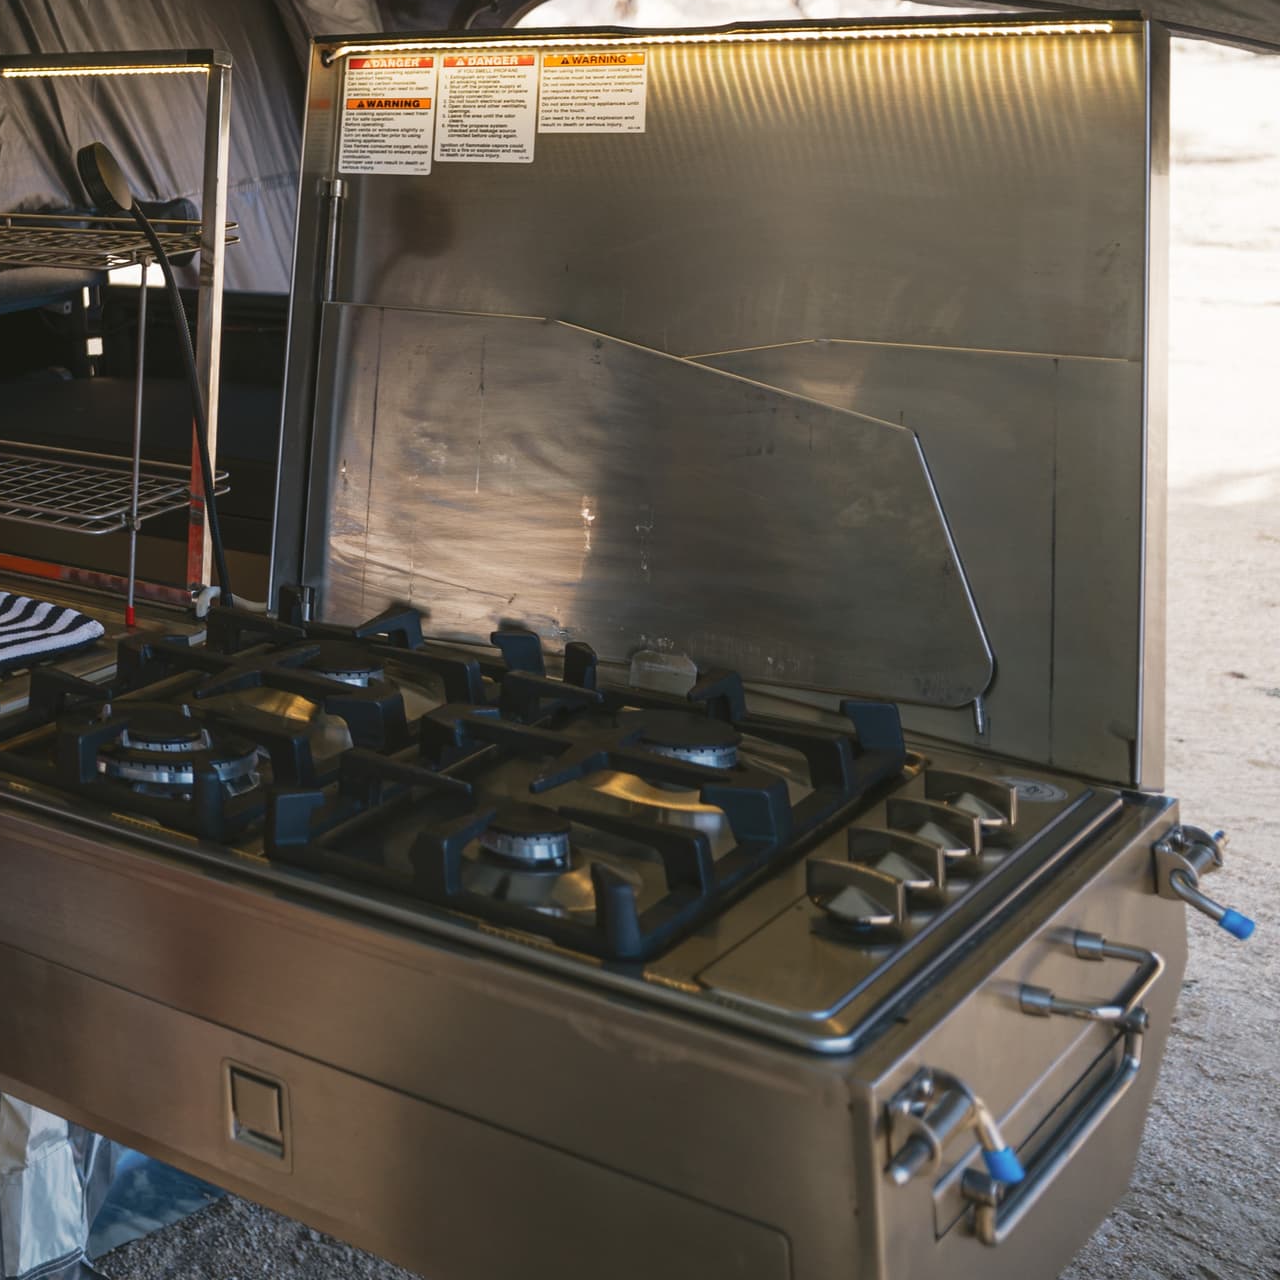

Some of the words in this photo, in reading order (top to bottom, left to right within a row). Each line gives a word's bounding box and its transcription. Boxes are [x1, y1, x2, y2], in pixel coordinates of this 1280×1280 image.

[372, 58, 419, 68] DANGER
[467, 56, 519, 66] DANGER
[571, 55, 627, 64] WARNING
[366, 99, 420, 108] WARNING
